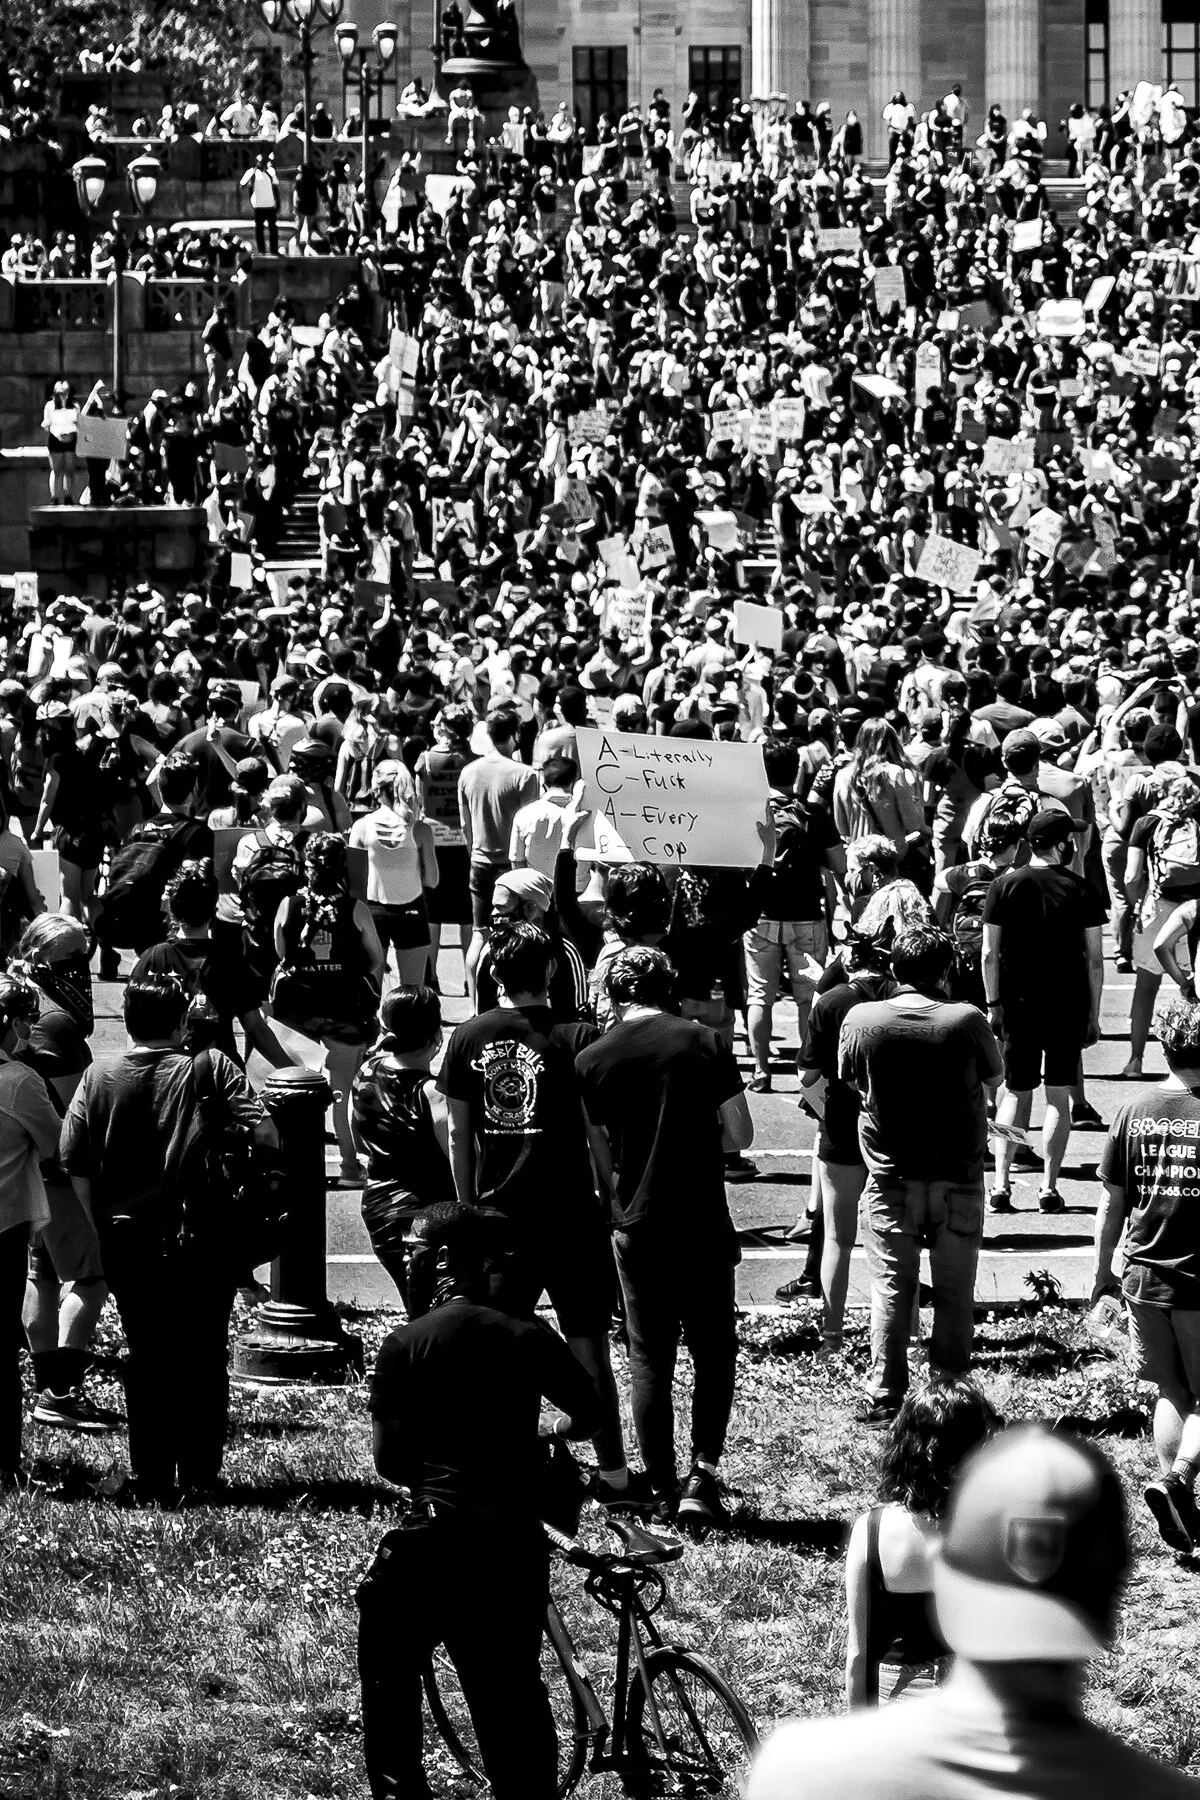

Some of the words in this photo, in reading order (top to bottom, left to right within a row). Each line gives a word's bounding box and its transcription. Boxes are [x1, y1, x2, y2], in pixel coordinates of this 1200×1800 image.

[642, 769, 686, 790] Fuck
[641, 805, 699, 832] Every
[642, 836, 688, 863] Cop
[1140, 1143, 1197, 1160] LEAGUE
